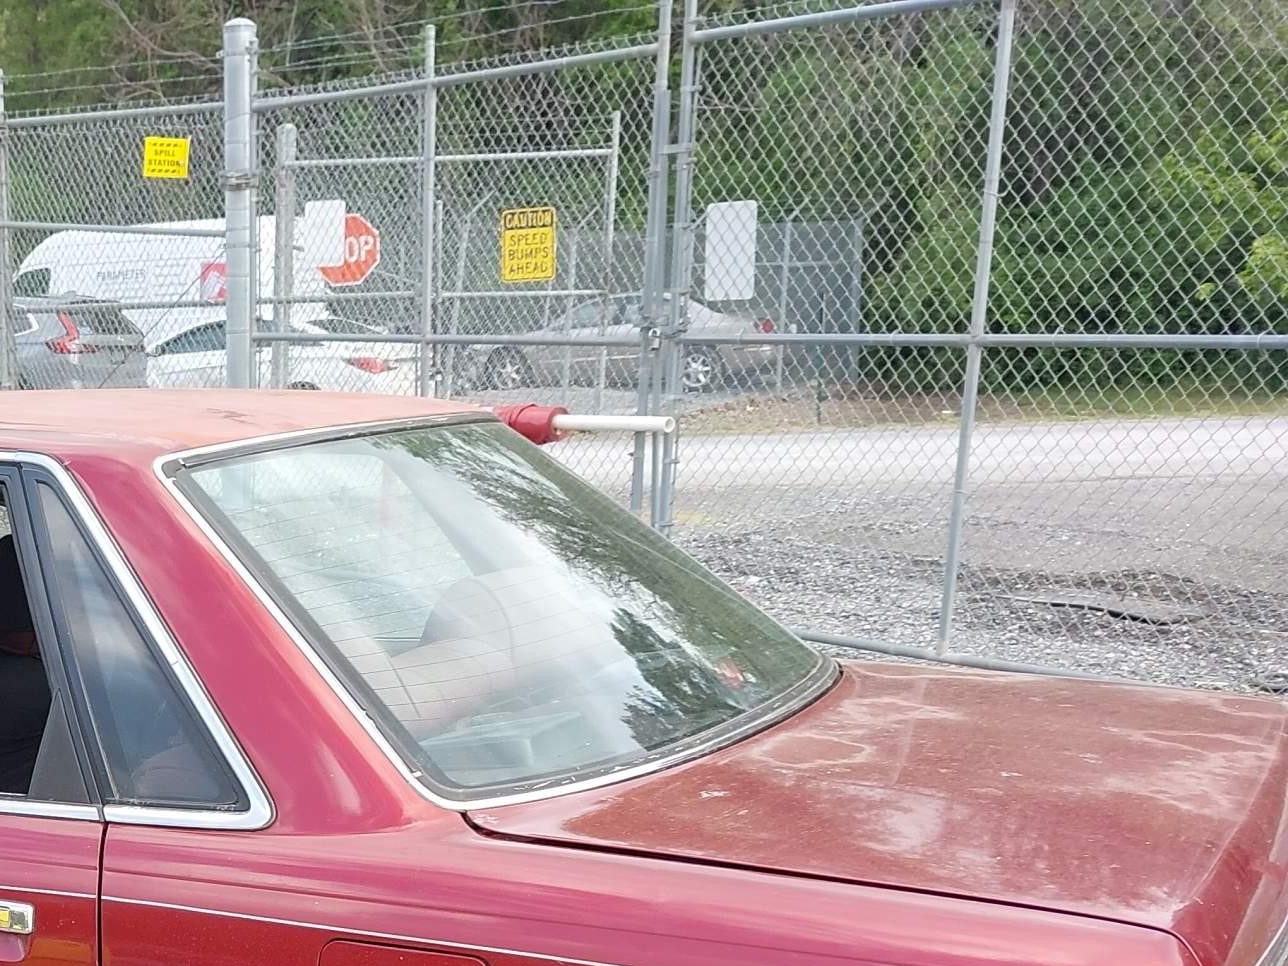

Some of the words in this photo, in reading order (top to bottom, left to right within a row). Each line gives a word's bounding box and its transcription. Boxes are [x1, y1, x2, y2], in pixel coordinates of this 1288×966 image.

[154, 149, 176, 157] SPILL
[148, 159, 181, 167] STATION
[505, 210, 552, 229] CAUTION
[509, 232, 548, 247] SPEED
[345, 235, 374, 263] OP
[508, 246, 549, 261] BUMPS
[508, 261, 549, 275] AHEAD
